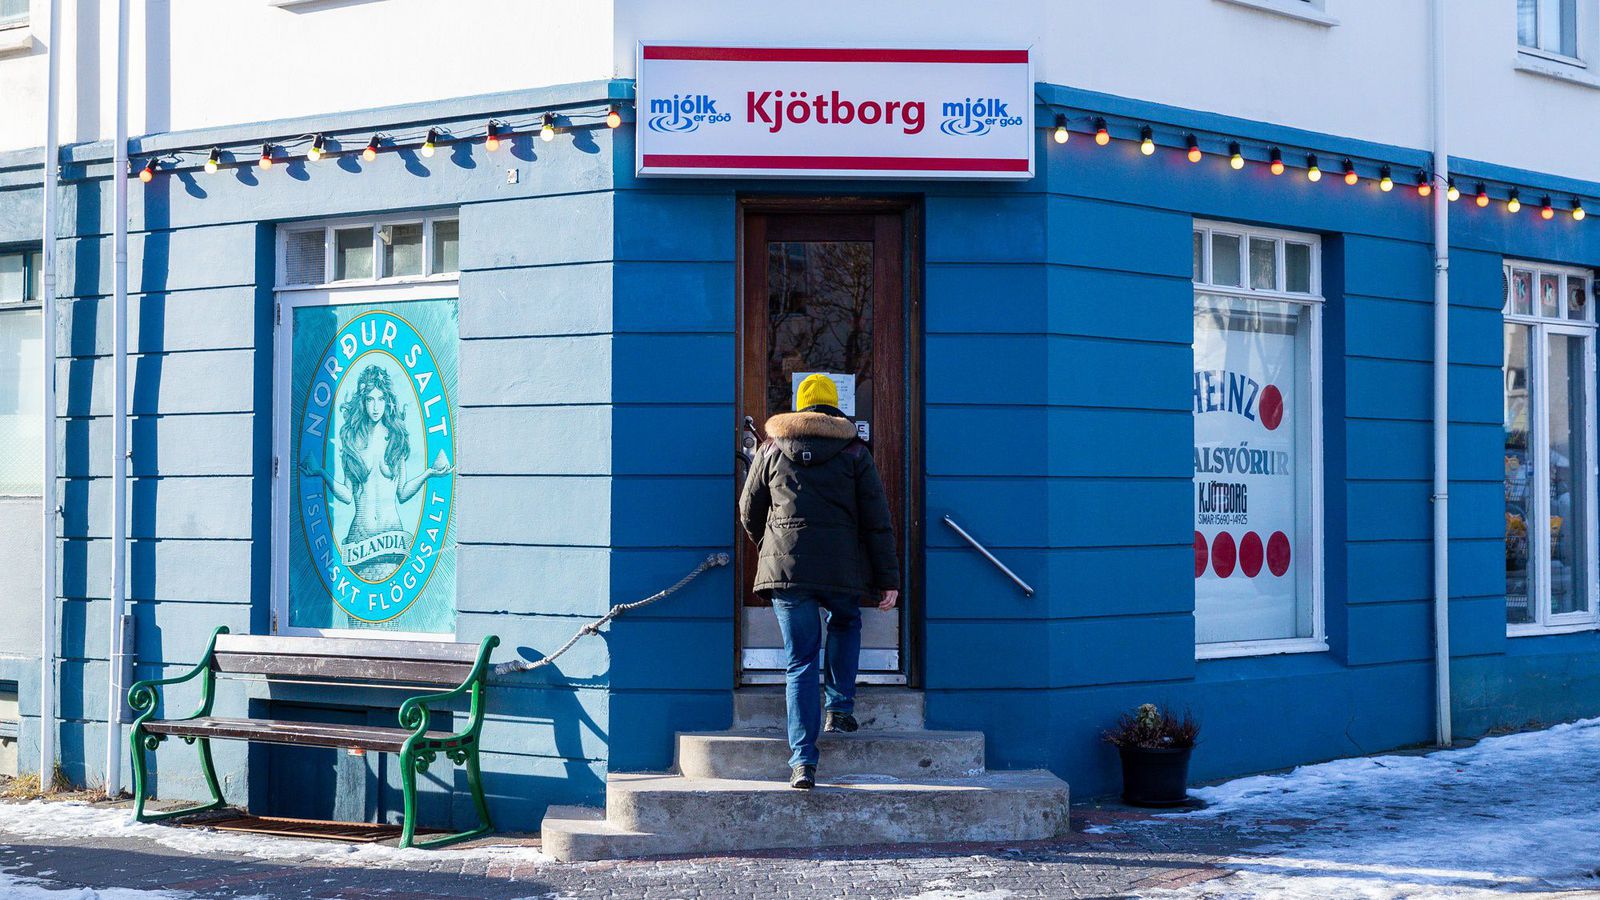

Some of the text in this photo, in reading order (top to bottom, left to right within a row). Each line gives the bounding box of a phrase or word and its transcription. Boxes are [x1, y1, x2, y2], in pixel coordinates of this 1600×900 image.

[650, 94, 717, 126] mjólk
[693, 114, 706, 122] er
[747, 90, 926, 135] Kjötborg
[942, 97, 1009, 129] mjólk
[985, 118, 998, 126] er
[305, 319, 448, 437] NORÐUR SALT
[1199, 480, 1248, 513] KJÖTBORG
[347, 534, 406, 562] ISLANDIA
[369, 491, 445, 611] FLÖGUSALT
